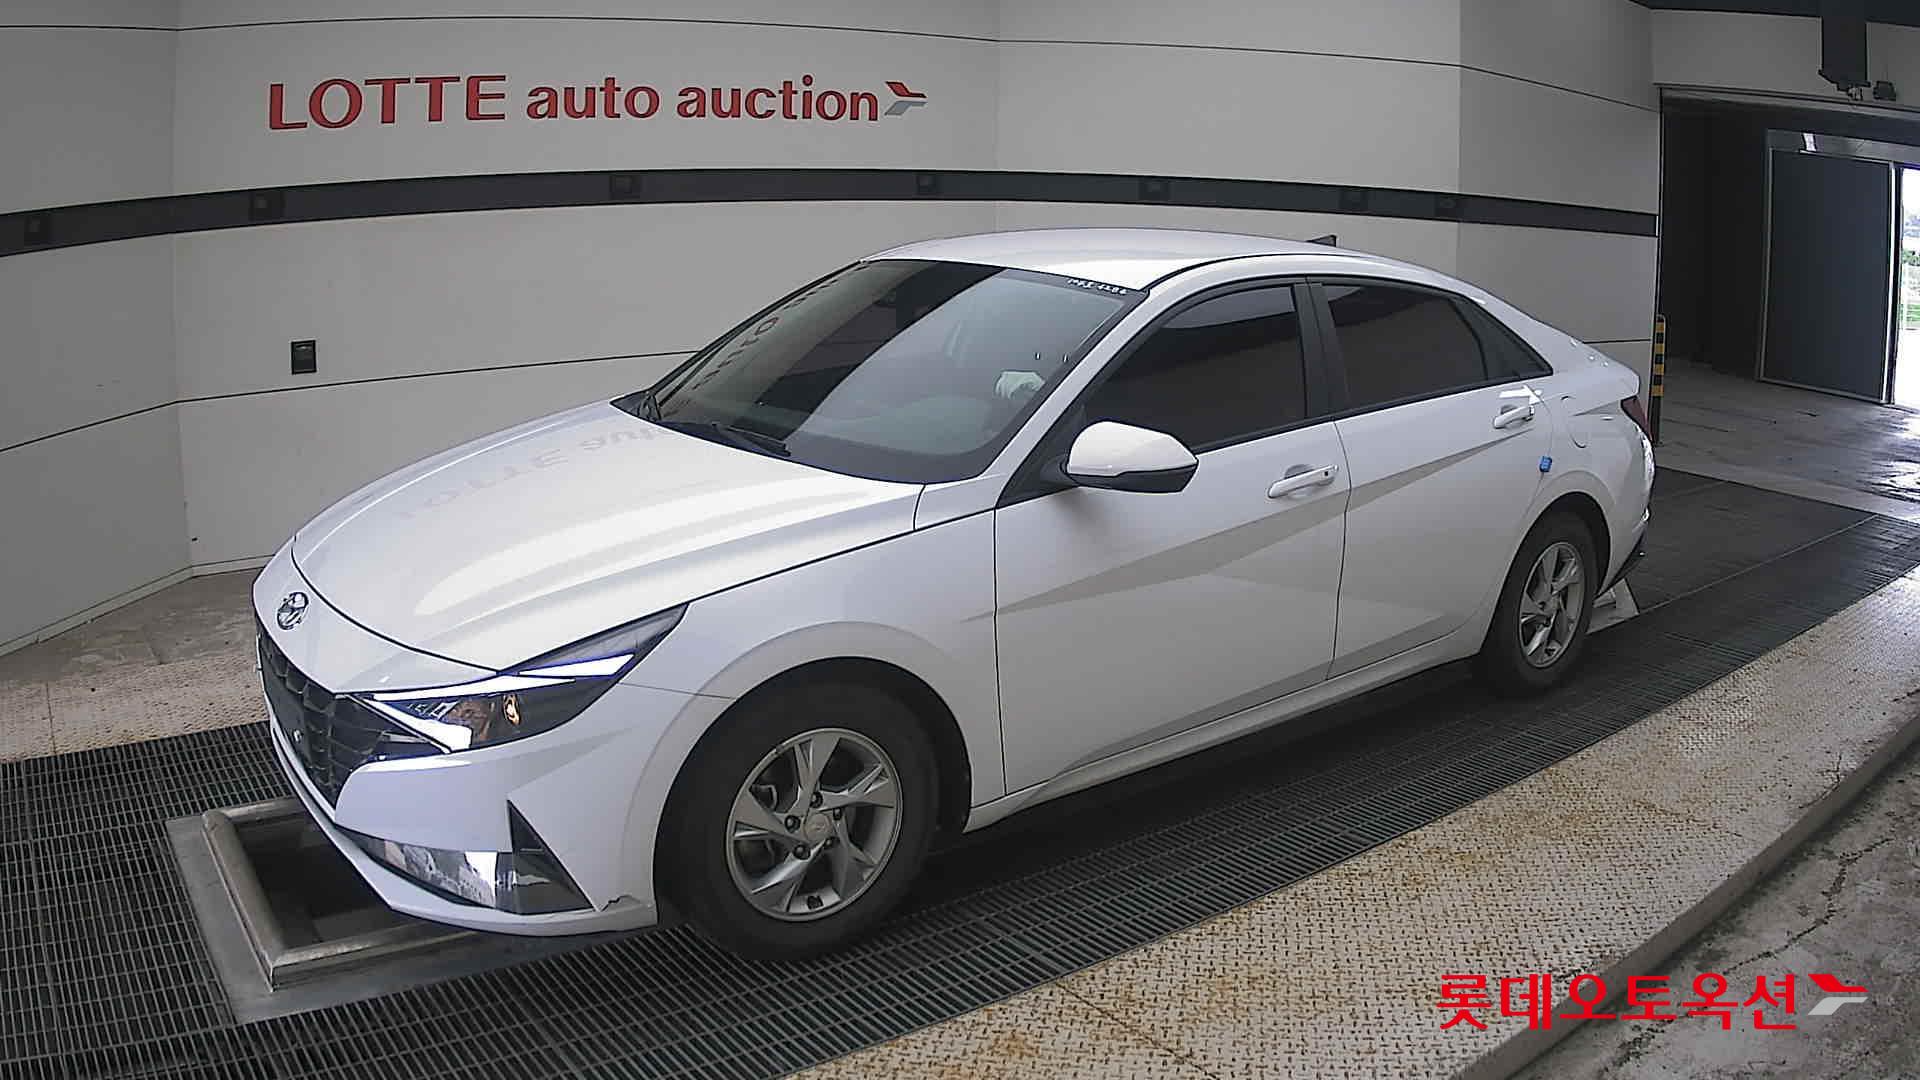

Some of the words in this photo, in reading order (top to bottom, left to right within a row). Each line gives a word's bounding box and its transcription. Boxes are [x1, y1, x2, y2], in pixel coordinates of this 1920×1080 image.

[269, 75, 507, 130] LOTTE
[526, 77, 660, 119] auto
[676, 75, 879, 121] auction
